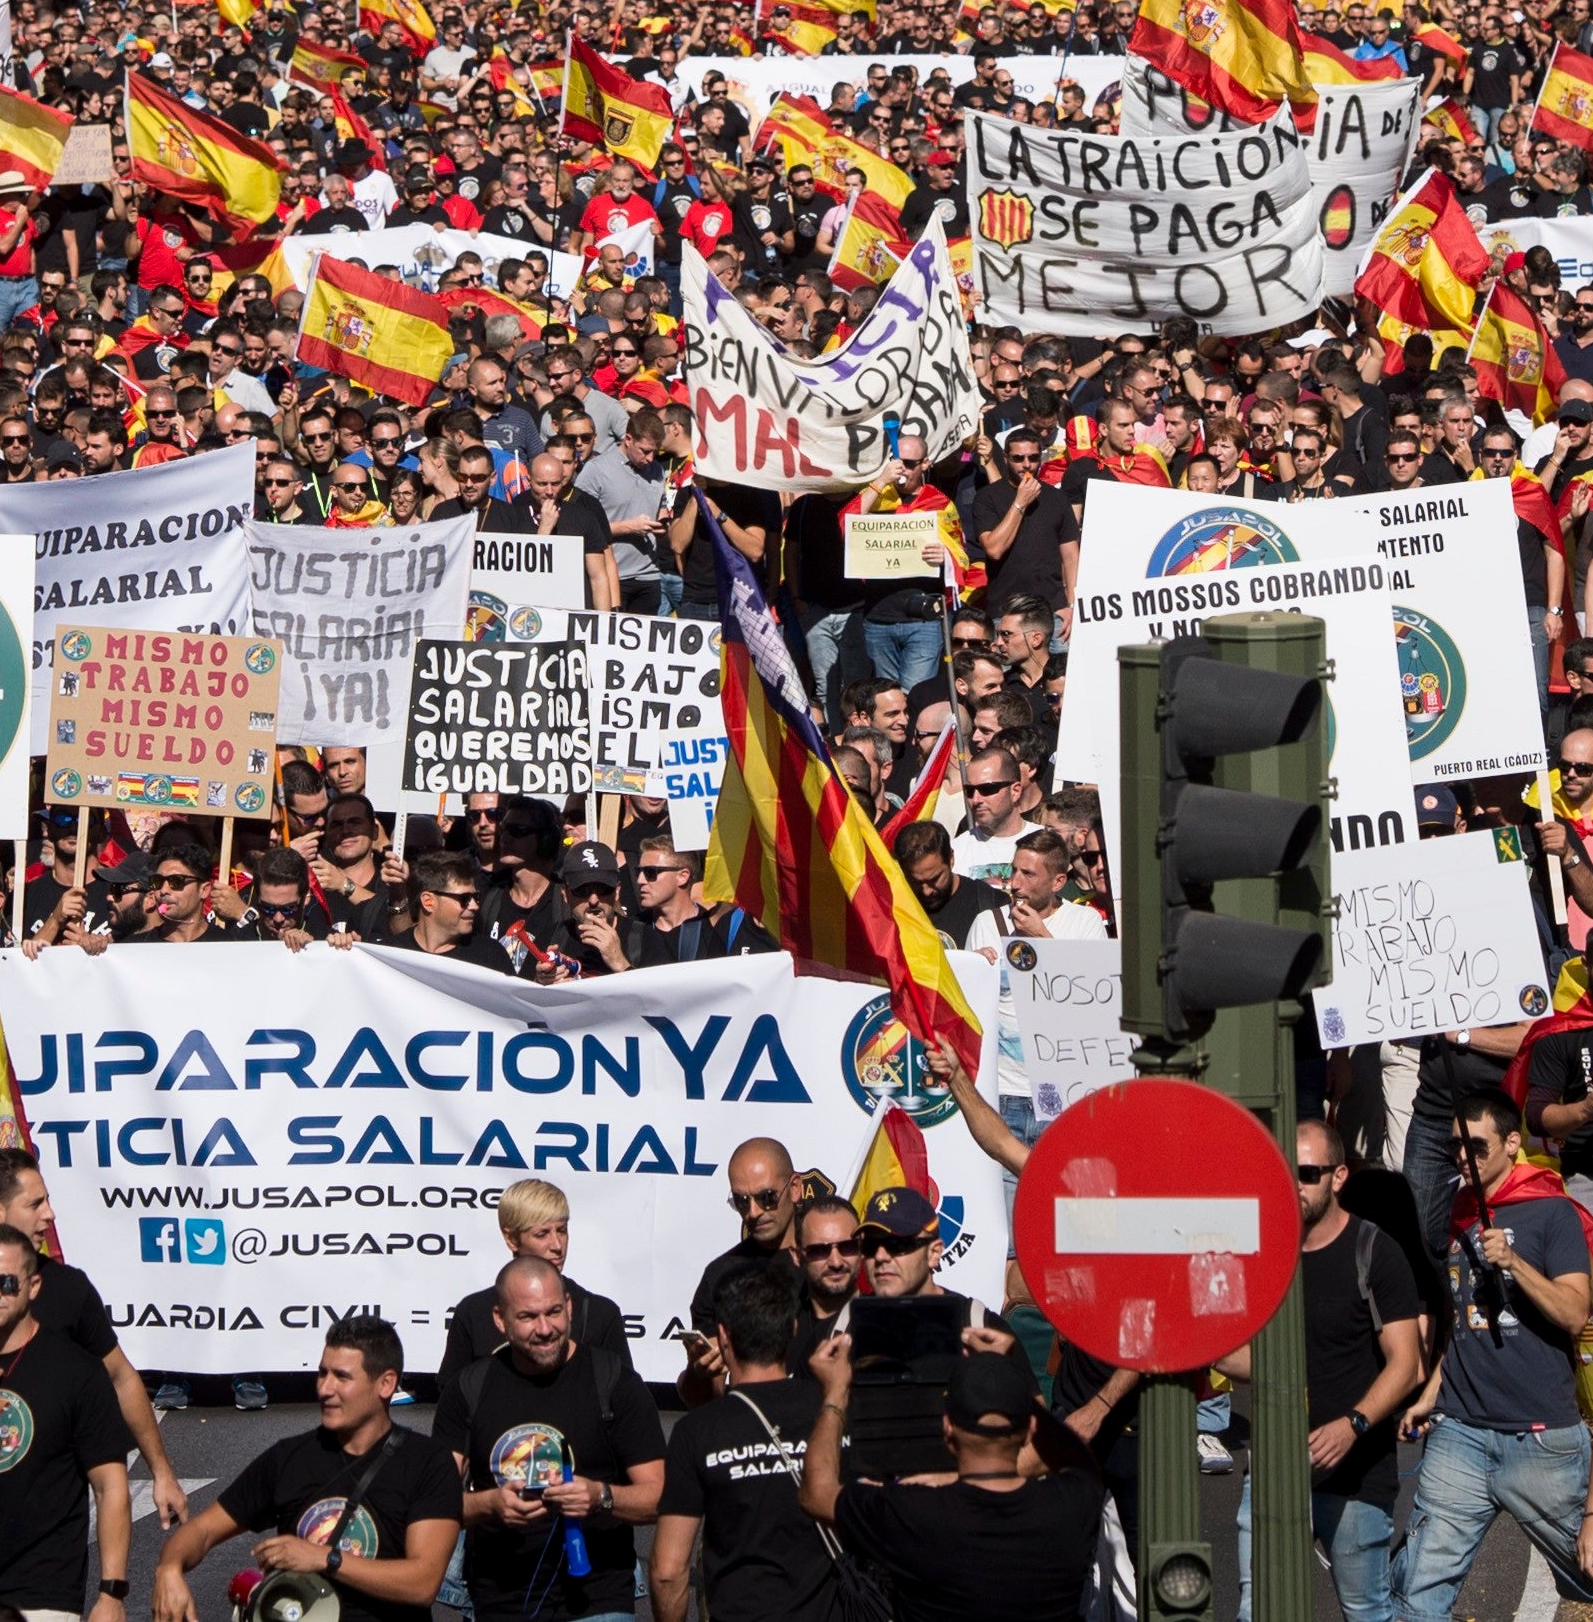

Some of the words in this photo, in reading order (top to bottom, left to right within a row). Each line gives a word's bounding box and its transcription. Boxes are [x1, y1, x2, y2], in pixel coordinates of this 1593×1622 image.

[974, 116, 1042, 187] LA
[1040, 195, 1099, 246] SE
[1130, 189, 1283, 255] PAGA
[979, 243, 1307, 319] MEJOR
[695, 387, 833, 479] MAL
[34, 503, 252, 560] UIPARACION
[1180, 509, 1284, 548] JUSAPOL
[1380, 498, 1469, 527] SALARIAL
[473, 540, 553, 573] RACION
[865, 538, 917, 550] SALARIAL
[249, 533, 446, 598] JUSTICIA
[884, 558, 901, 569] YA
[1077, 594, 1123, 624] LOS
[1132, 581, 1241, 617] MOSSOS
[1250, 563, 1384, 603] COBRANDO
[105, 633, 228, 666] MISMO
[567, 613, 704, 655] MISMO
[80, 662, 249, 698] TRABAJO
[420, 647, 590, 688] JUSTICIA
[604, 660, 722, 698] BAJO
[101, 698, 224, 731] MISMO
[414, 687, 590, 728] SALARIAL
[601, 693, 701, 730] ISMO
[85, 730, 235, 765] SUELDO
[415, 728, 592, 761] QUEREMOS
[664, 736, 730, 766] JUST
[666, 772, 721, 799] SAL
[1434, 759, 1474, 776] PUERTO
[1476, 757, 1501, 773] REAL
[1337, 879, 1435, 931] MISMO
[1335, 915, 1457, 967] RABAJO
[1032, 972, 1122, 1005] NOSOT
[1367, 947, 1500, 1005] MISMO
[1365, 991, 1501, 1034] SUELDO
[285, 1114, 720, 1176] SALARIAL
[100, 1185, 505, 1210] WWW.JUSAPOL.ORG
[232, 1226, 470, 1264] @JUSAPOL
[106, 1303, 264, 1331] UARDIA
[729, 1459, 805, 1480] SALARI
